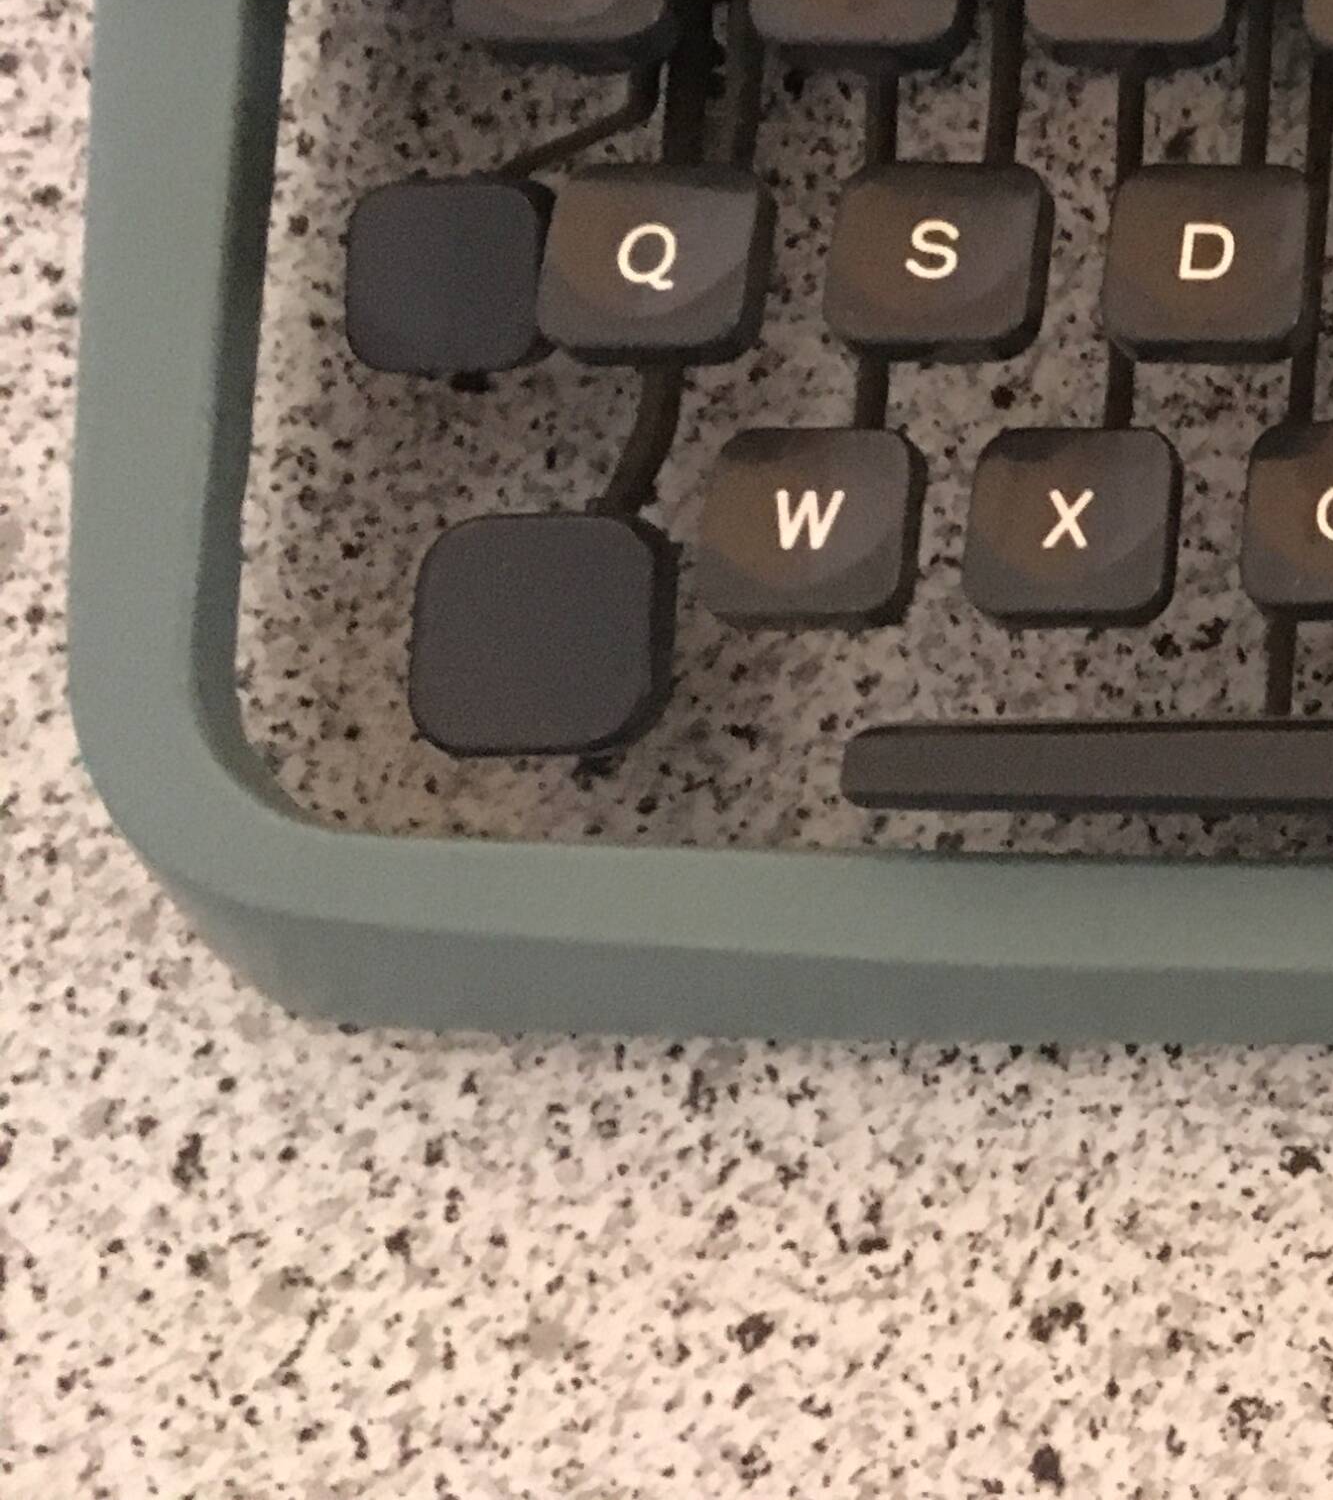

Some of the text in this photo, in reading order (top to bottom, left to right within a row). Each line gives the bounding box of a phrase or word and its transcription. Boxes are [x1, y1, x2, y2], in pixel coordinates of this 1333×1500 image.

[615, 222, 678, 293] Q
[903, 218, 962, 282] S
[1176, 221, 1237, 282] D
[774, 487, 847, 552] W
[1040, 487, 1096, 551] X
